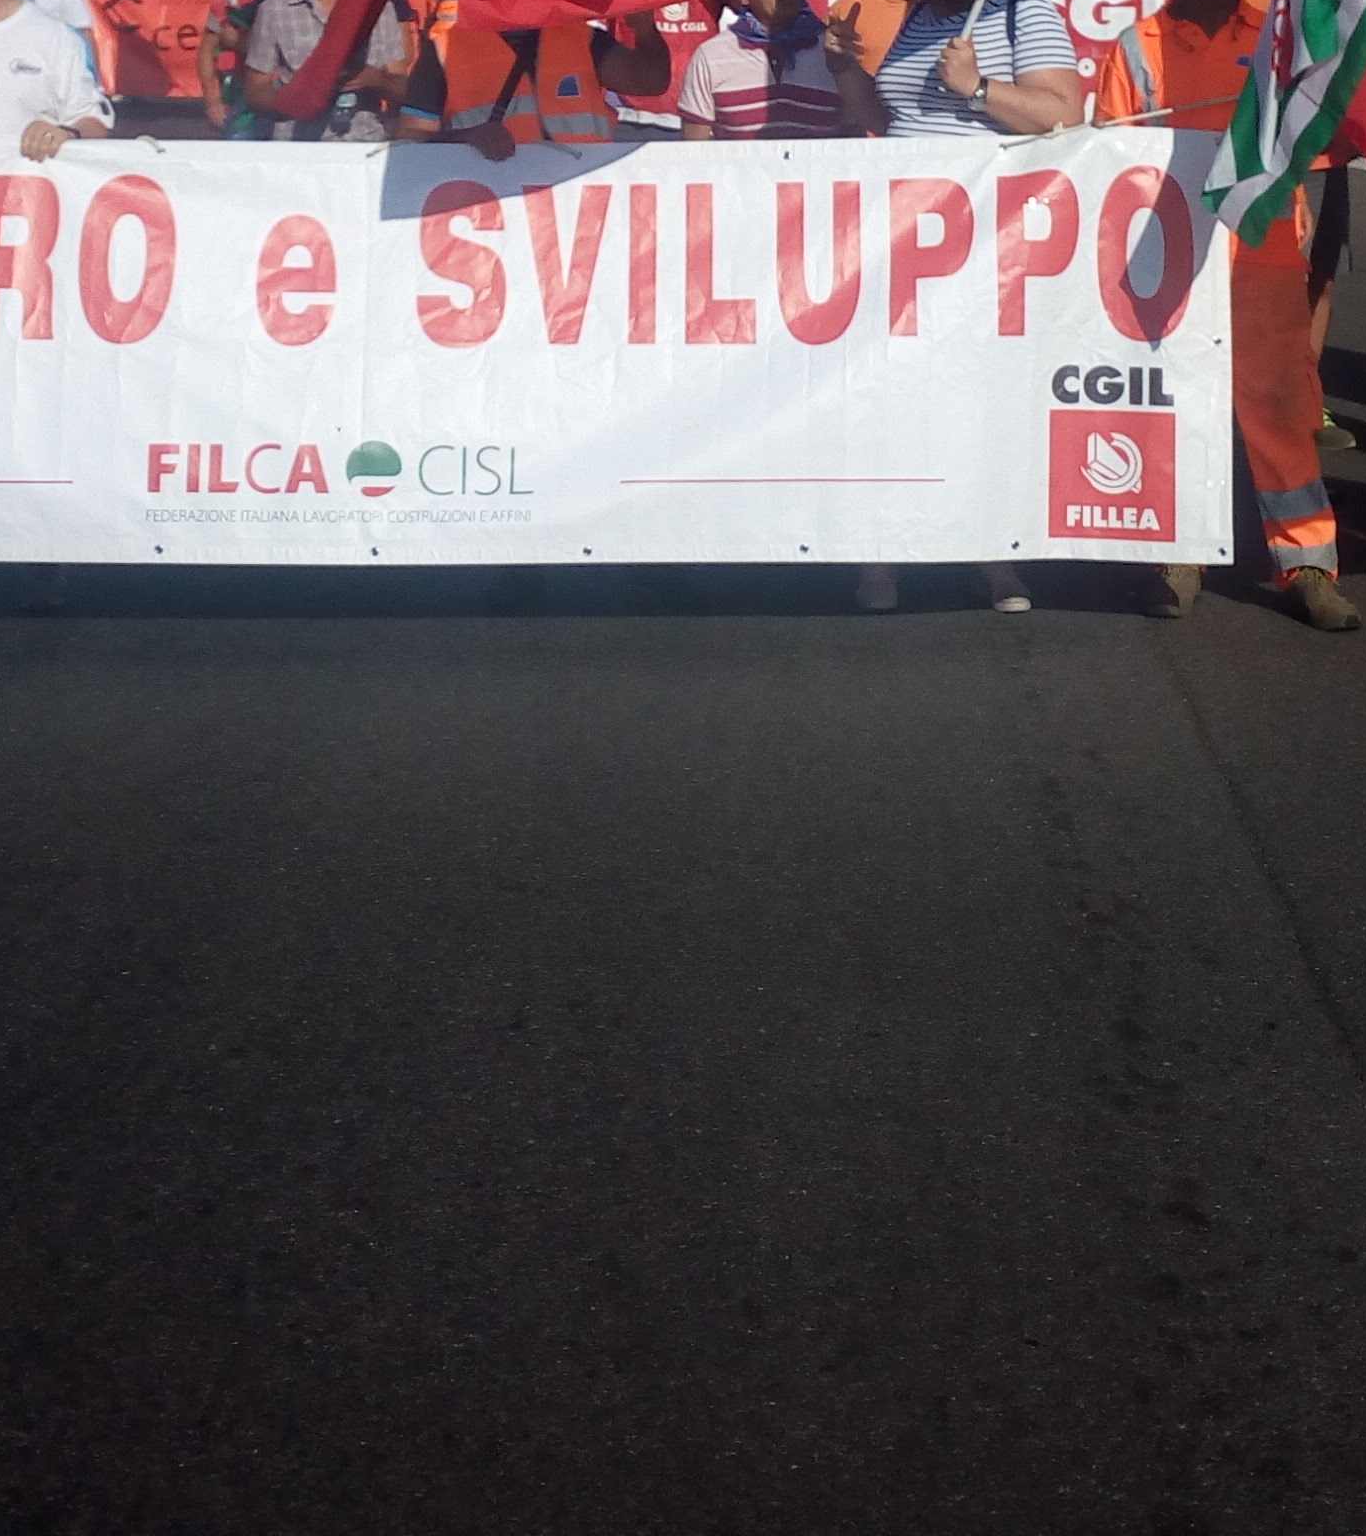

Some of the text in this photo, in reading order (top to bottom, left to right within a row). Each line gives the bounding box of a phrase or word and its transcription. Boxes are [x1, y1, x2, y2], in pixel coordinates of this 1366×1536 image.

[257, 214, 337, 347] e
[415, 165, 1194, 348] SVILUPPO
[1051, 364, 1175, 407] CGIL
[146, 443, 534, 496] FILCA CISL
[145, 507, 237, 524] FEDERAZIONE
[240, 508, 299, 524] ITALIANA
[303, 508, 383, 525] LAVORATORI
[387, 508, 476, 525] COSTRUZIONI
[491, 508, 532, 524] AFFINI
[1066, 504, 1161, 531] FILLEA
